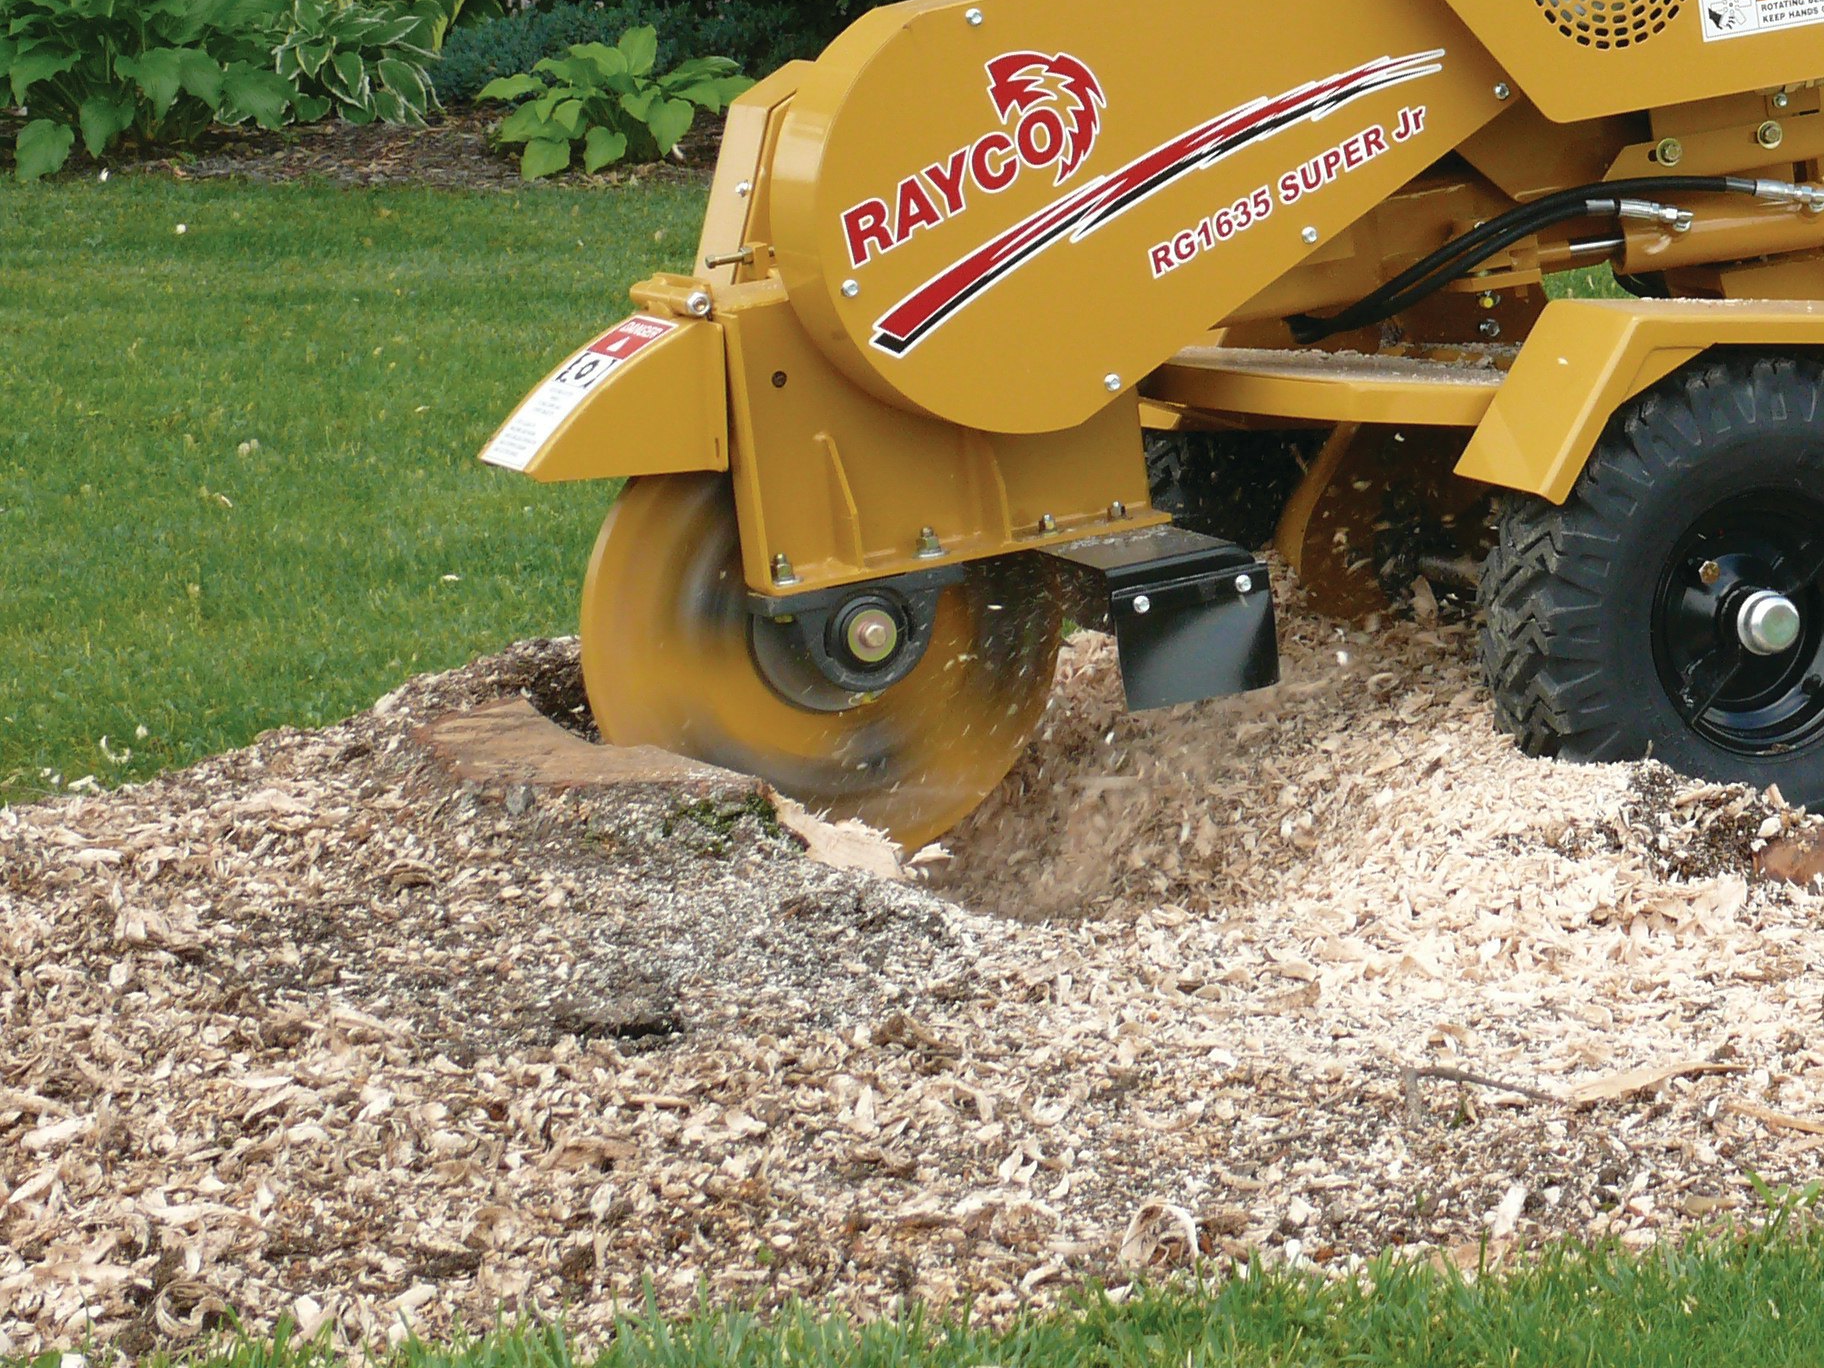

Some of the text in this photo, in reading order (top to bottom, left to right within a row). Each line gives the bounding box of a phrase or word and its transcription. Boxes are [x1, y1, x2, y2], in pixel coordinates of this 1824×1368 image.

[1763, 13, 1785, 23] KEEP
[1788, 7, 1818, 19] HANDS
[841, 108, 1066, 269] RAYCO
[1146, 105, 1428, 279] RG1635 SUPER Jr
